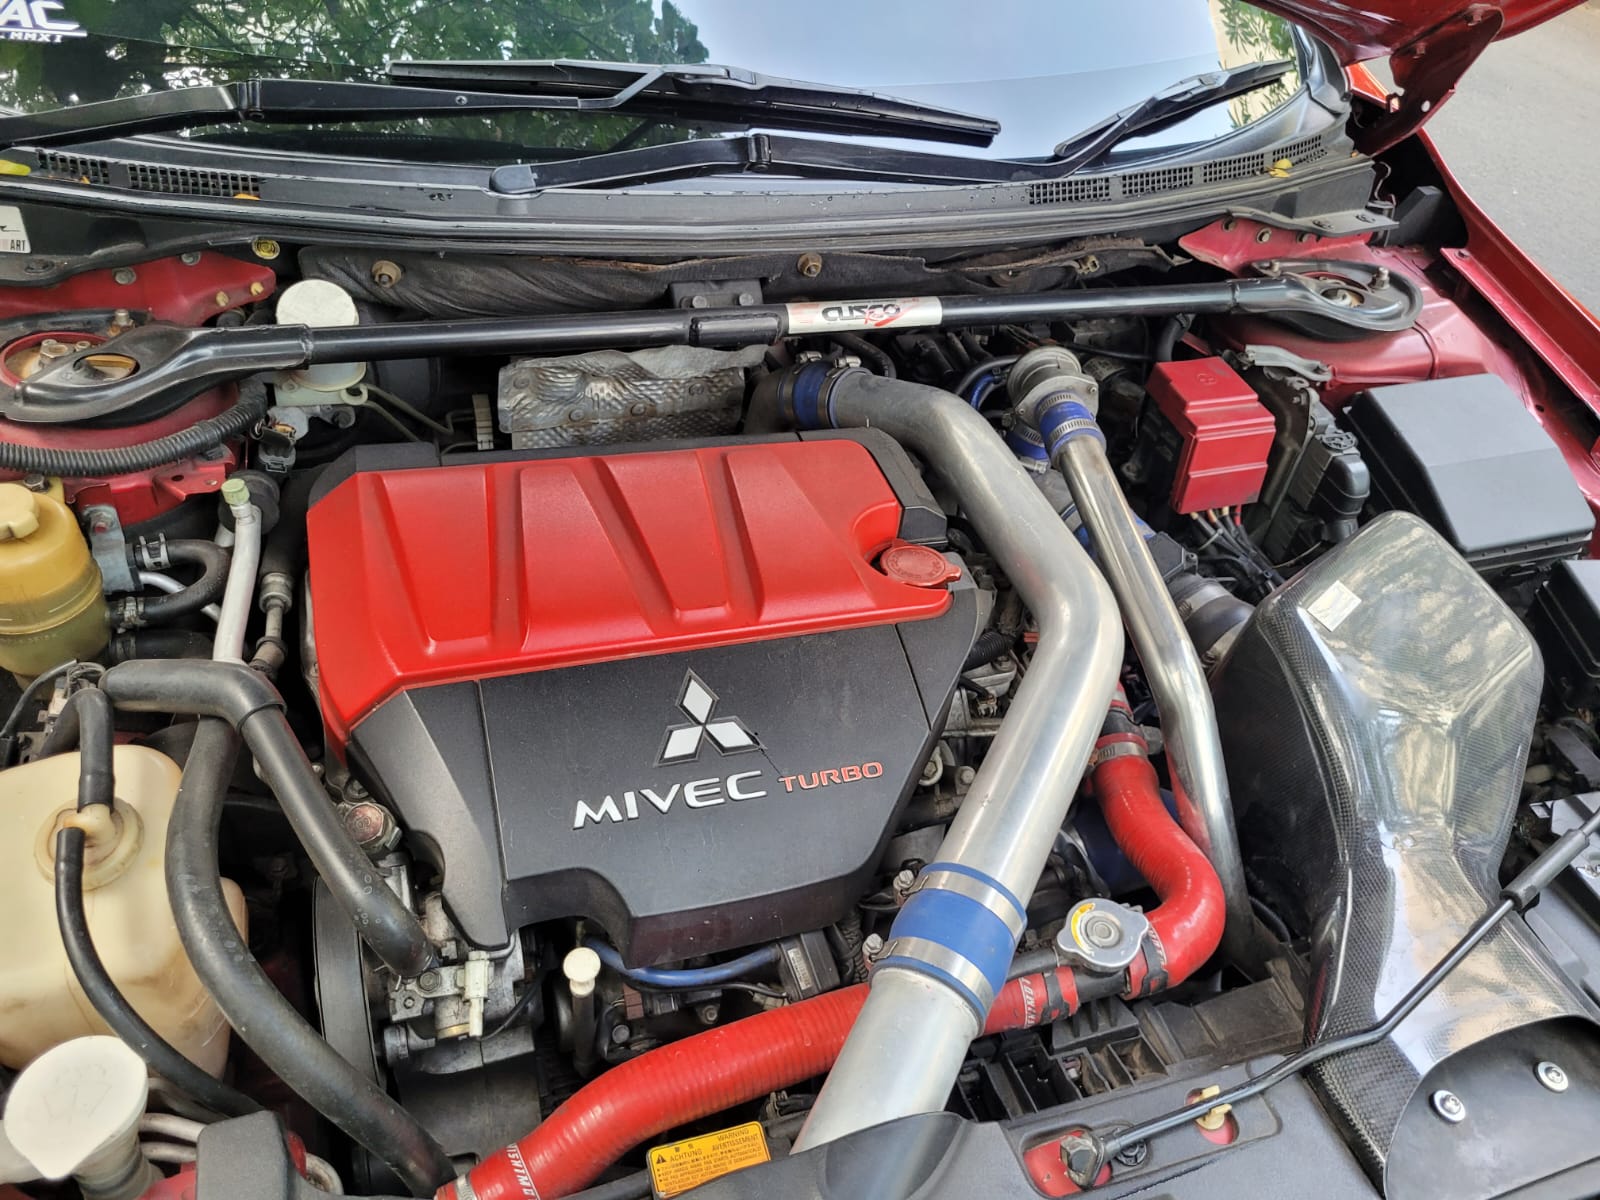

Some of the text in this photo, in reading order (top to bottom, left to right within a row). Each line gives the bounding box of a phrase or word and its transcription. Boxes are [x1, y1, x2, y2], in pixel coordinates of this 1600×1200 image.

[0, 0, 80, 30] AC
[822, 303, 901, 321] CUSCO
[572, 761, 884, 830] MIVEC TURBO
[717, 1128, 750, 1141] WARNING
[670, 1149, 703, 1162] ACHTUNG
